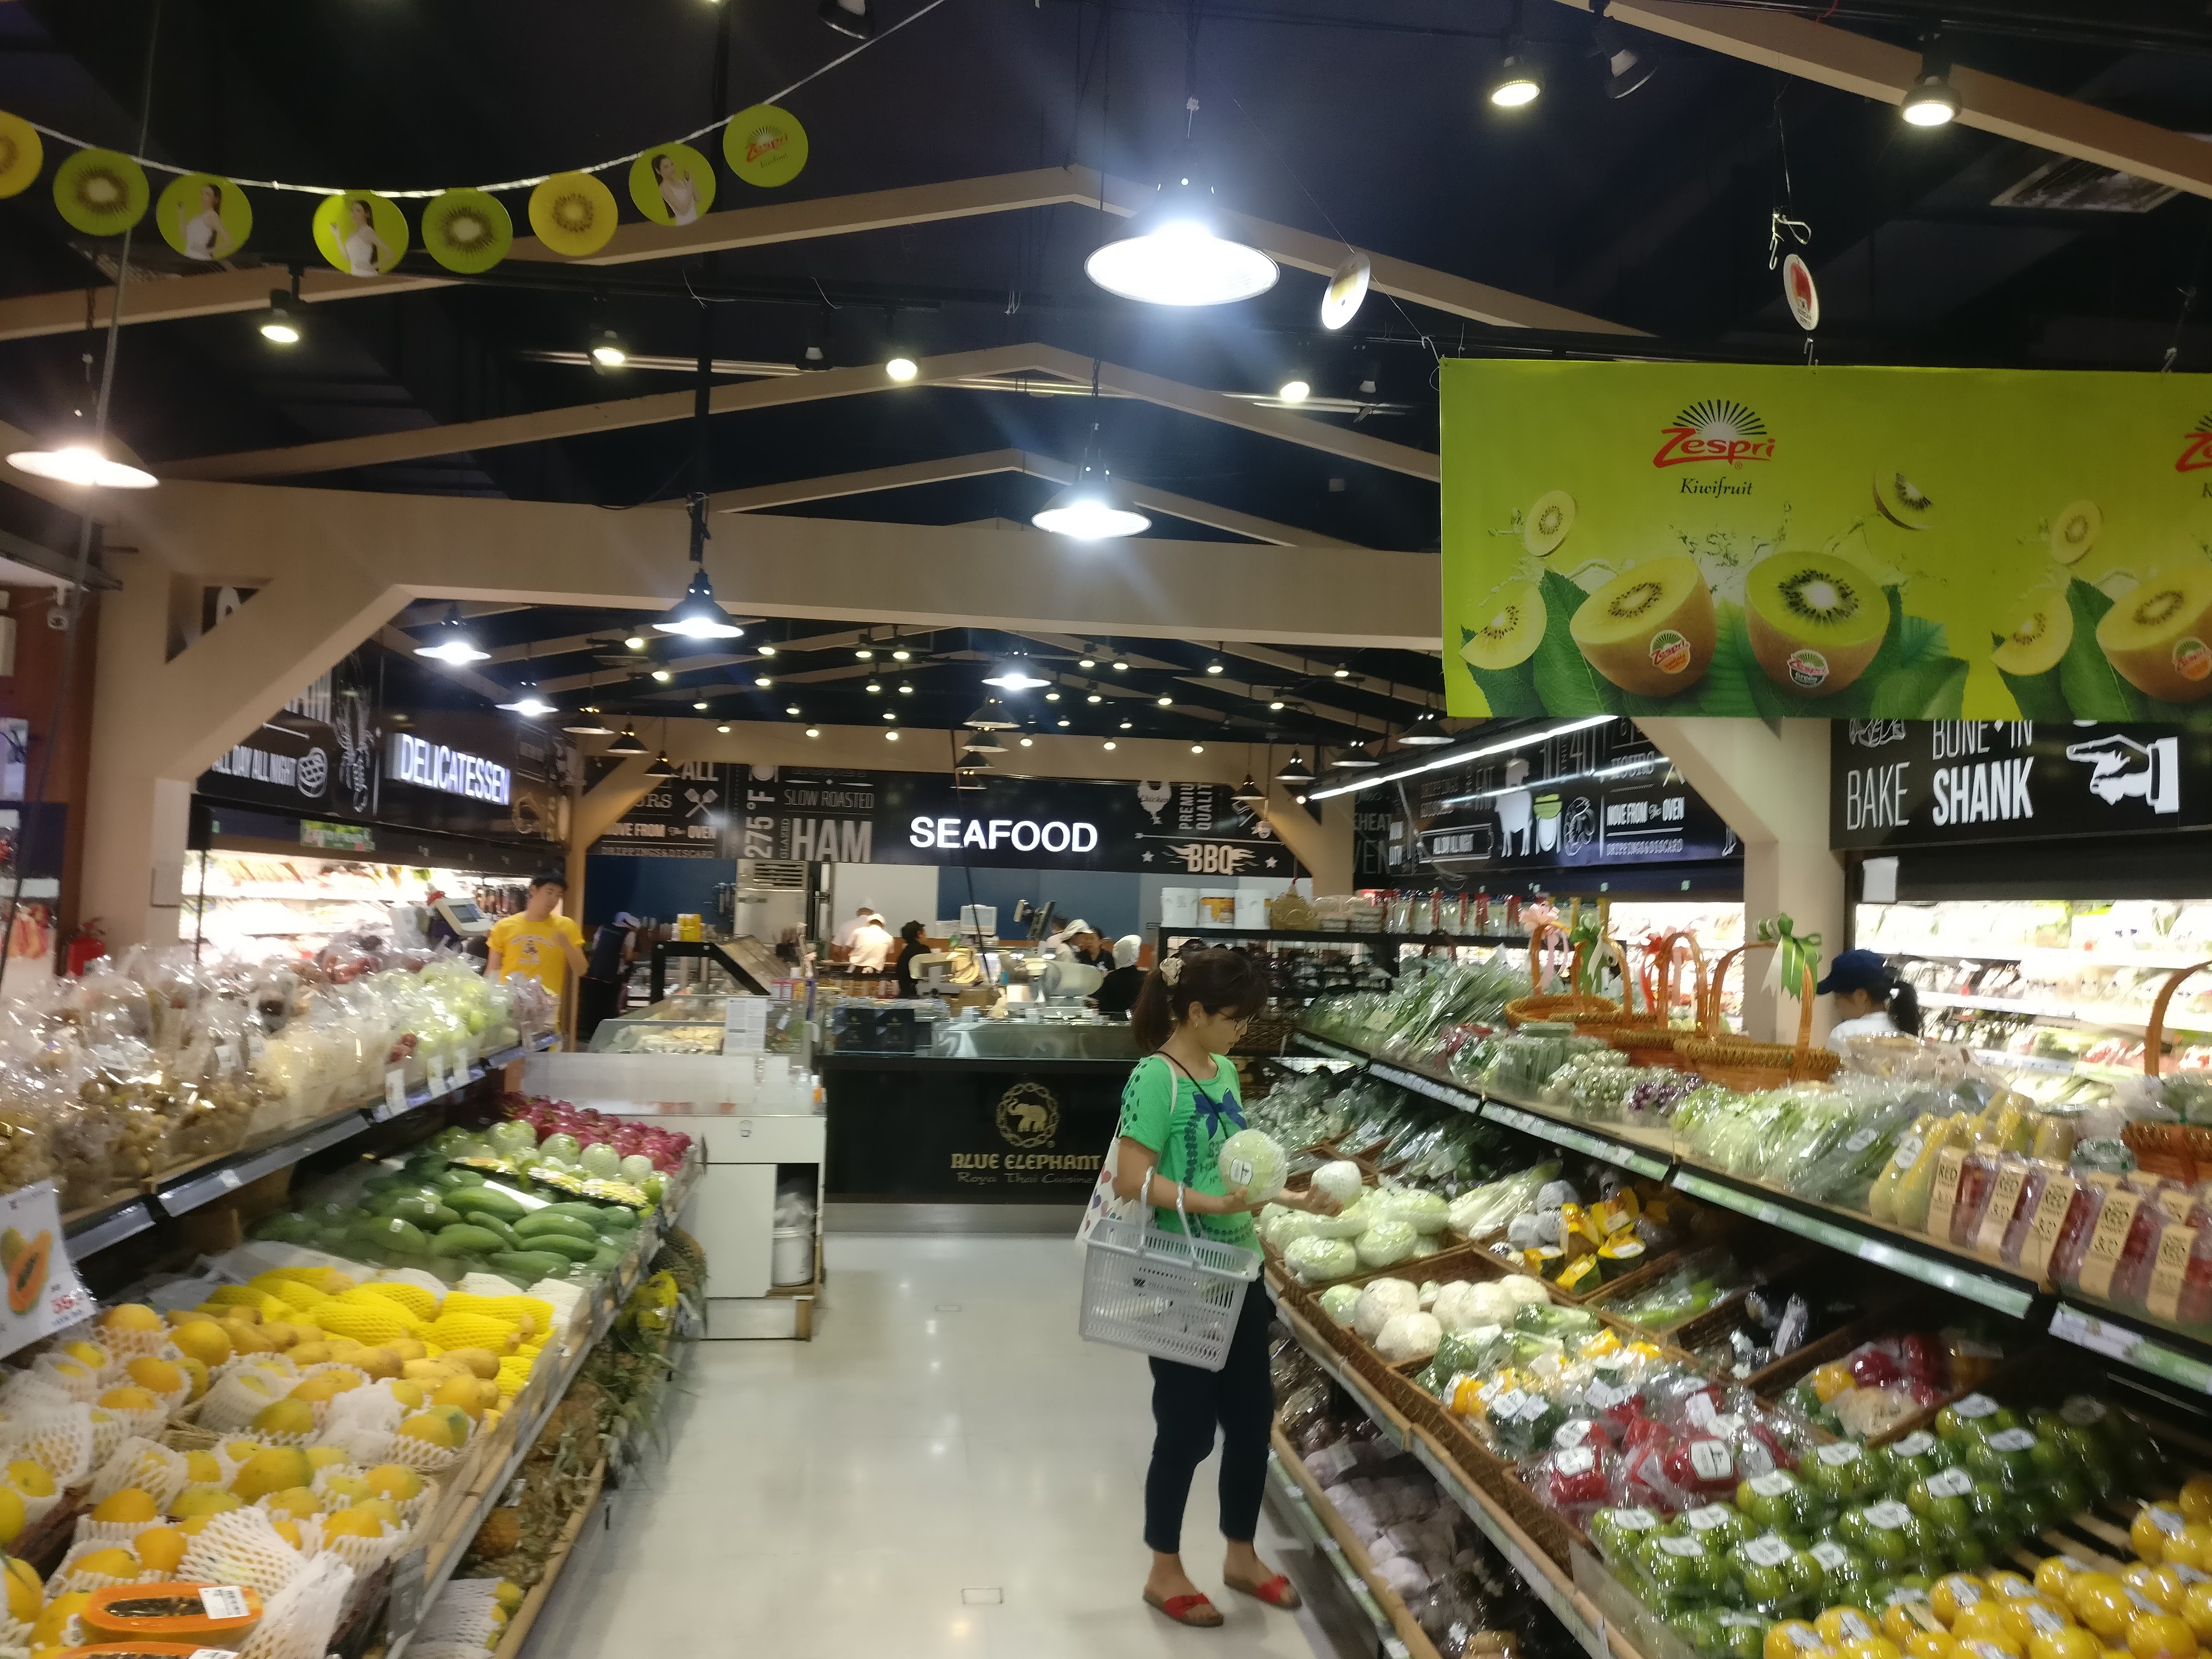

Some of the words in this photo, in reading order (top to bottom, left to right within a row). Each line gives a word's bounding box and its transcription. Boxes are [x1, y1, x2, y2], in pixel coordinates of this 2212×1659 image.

[1653, 427, 1775, 469] Zespri
[1680, 477, 1753, 498] Kiwifruit
[1932, 719, 1990, 760] BONE
[2010, 719, 2033, 749] IN
[399, 734, 511, 806] DELICATESSEN
[784, 789, 819, 806] SLOW
[821, 791, 875, 809] ROASTED
[1178, 783, 1195, 830] PREMIU
[1195, 783, 1213, 831] QUALIT
[1846, 761, 1911, 830] BAKE
[1932, 756, 2035, 828] SHANK
[790, 818, 873, 863] HAM
[910, 816, 1098, 853] SEAFOOD
[1186, 843, 1235, 876] BBQ
[950, 1153, 1000, 1169] BLUE
[1003, 1154, 1102, 1170] ELEPHANT
